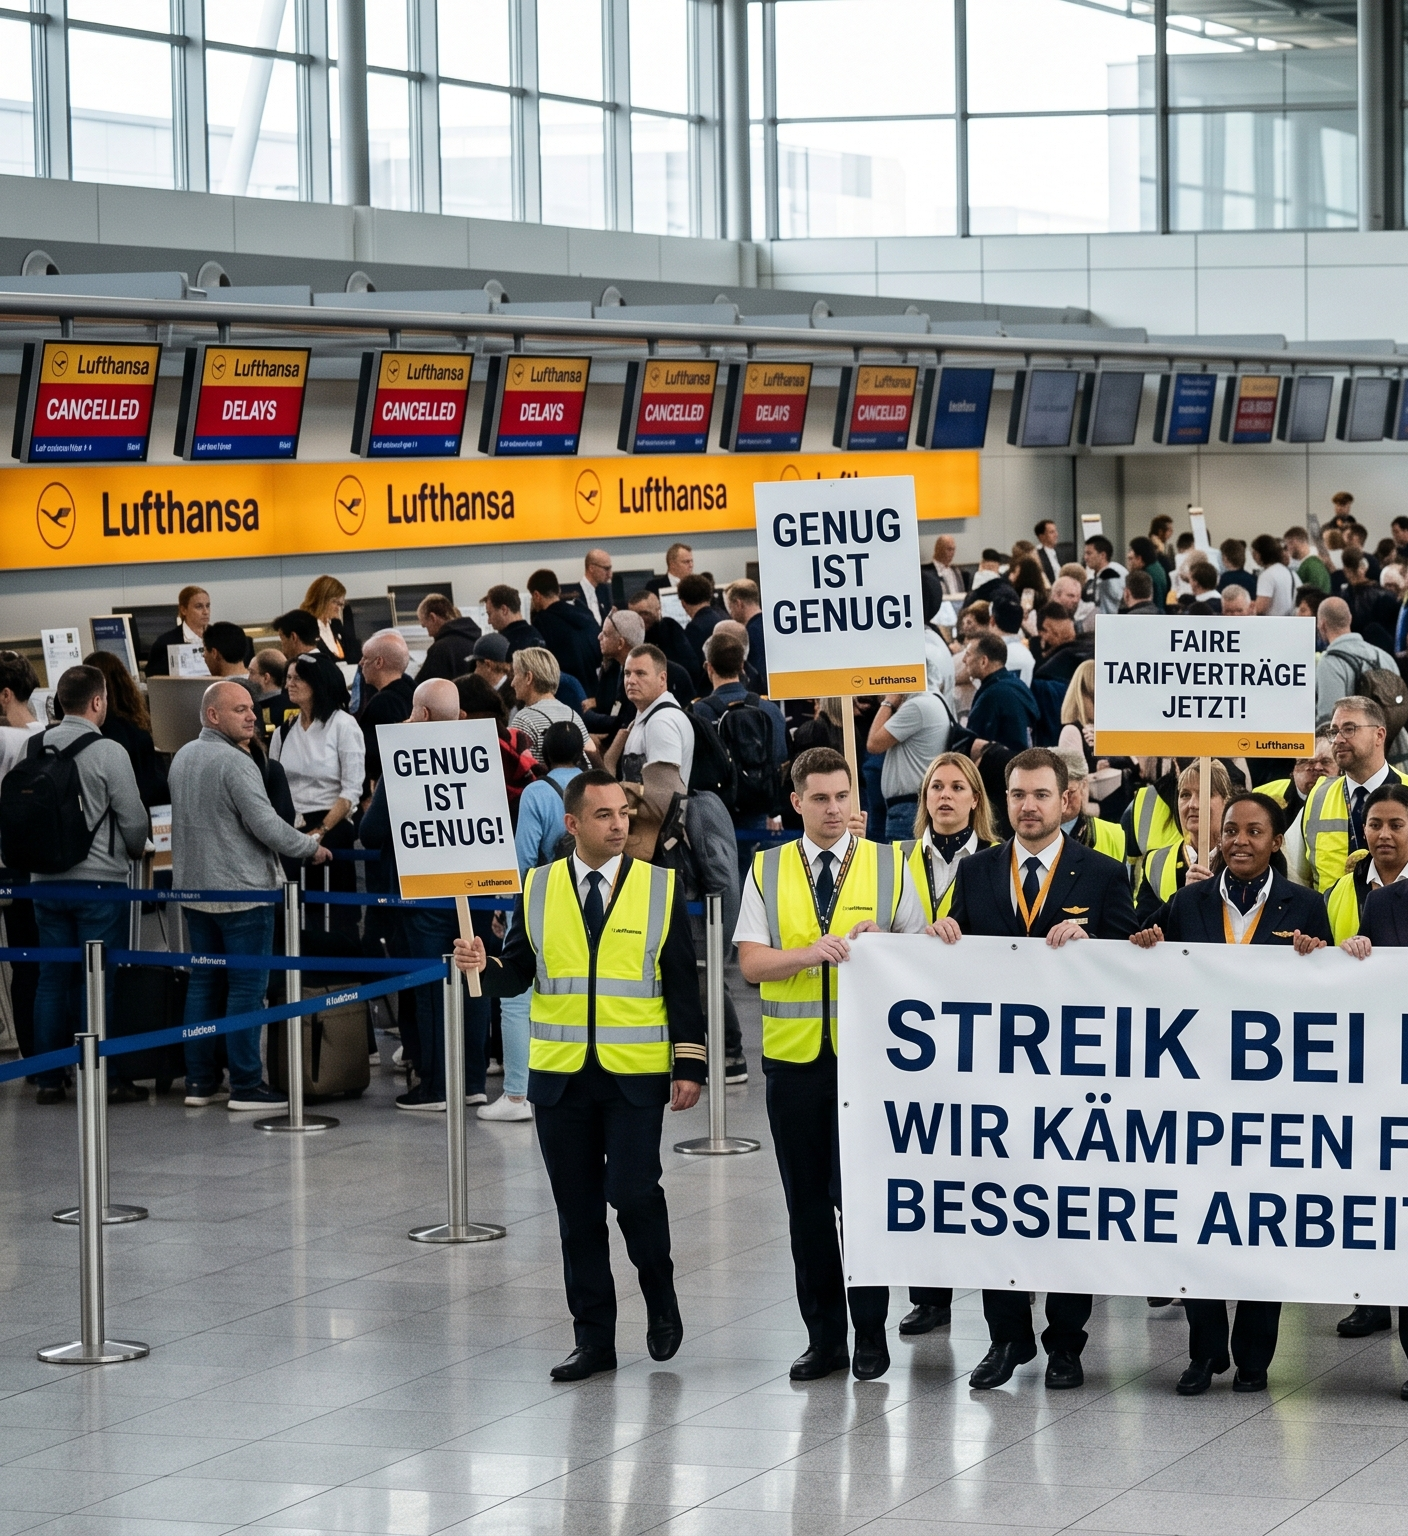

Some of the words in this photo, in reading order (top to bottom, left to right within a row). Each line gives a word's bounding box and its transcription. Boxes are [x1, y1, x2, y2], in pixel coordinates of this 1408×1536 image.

[77, 355, 150, 375] Lufthansa
[234, 358, 300, 378] Lufthansa
[407, 363, 464, 381] Lufthansa
[530, 366, 582, 383] Lufthansa
[46, 398, 139, 420] CANCELLED
[222, 400, 277, 420] DELAYS
[382, 401, 456, 421] CANCELLED
[519, 403, 564, 421] DELAYS
[645, 404, 705, 421] CANCELLED
[858, 405, 907, 421] CANCELLED
[387, 482, 515, 524] Lufthansa
[619, 476, 727, 514] Lufthansa
[102, 489, 259, 537] Lufthansa
[773, 508, 901, 547] GENUG
[812, 552, 869, 589] IST
[772, 594, 912, 635] GENUG!
[1170, 629, 1241, 654] FAIRE
[869, 676, 917, 686] Lufthansa
[1103, 657, 1307, 687] TARIFVERTRÄGE
[1162, 695, 1247, 720] JETZT!
[1256, 740, 1305, 750] Lufthansa
[393, 745, 490, 777] GENUG
[424, 782, 467, 812] IST
[400, 816, 505, 849] GENUG!
[886, 999, 1200, 1080] STREIK
[1230, 1009, 1365, 1084] BEI
[884, 1100, 1009, 1159] WIR
[1033, 1092, 1353, 1170] KÄMPFEN
[886, 1178, 1178, 1244] BESSERE
